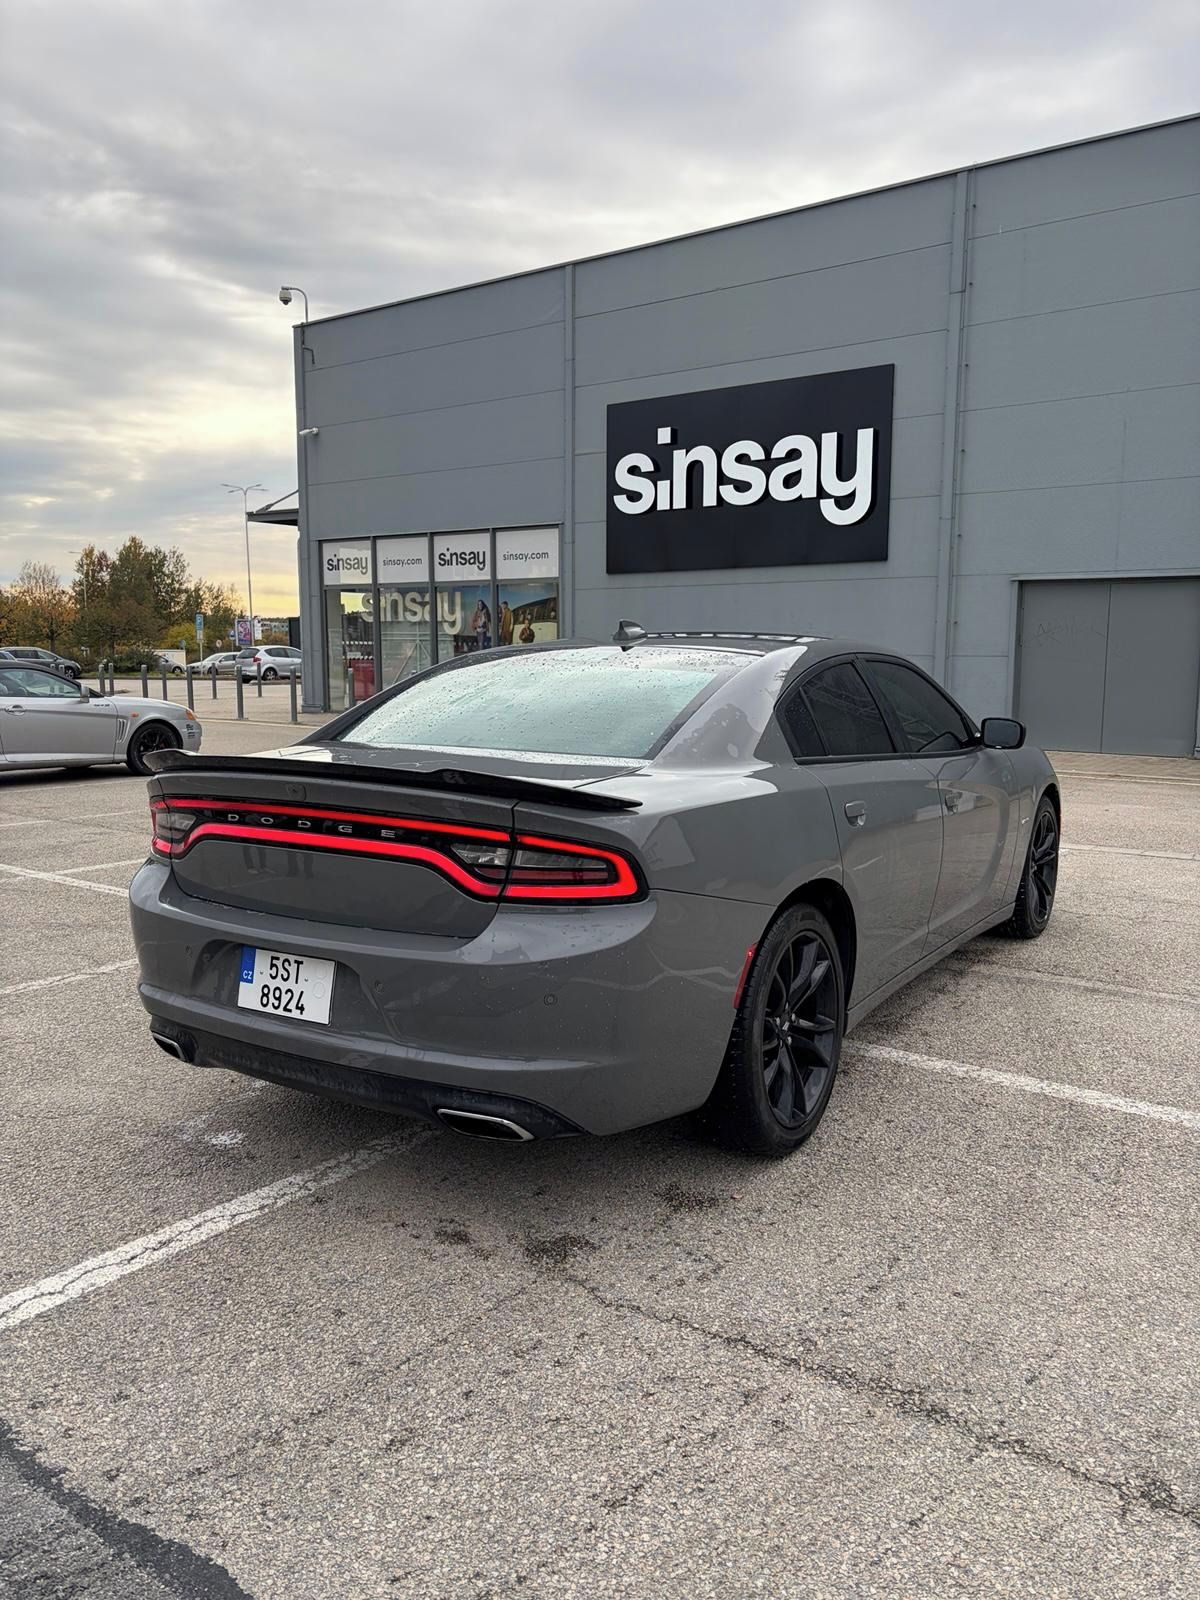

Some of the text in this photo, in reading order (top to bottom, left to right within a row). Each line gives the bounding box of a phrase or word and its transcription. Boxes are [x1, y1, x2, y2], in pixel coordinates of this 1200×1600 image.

[613, 426, 874, 526] sinsay
[326, 553, 369, 576] sinsay
[382, 557, 423, 568] sinsay.com
[438, 547, 486, 571] sinsay
[502, 550, 549, 562] sinsay.com
[228, 813, 397, 838] DODGE
[242, 970, 253, 980] CZ
[269, 955, 304, 985] 5ST
[260, 984, 305, 1015] 8924
